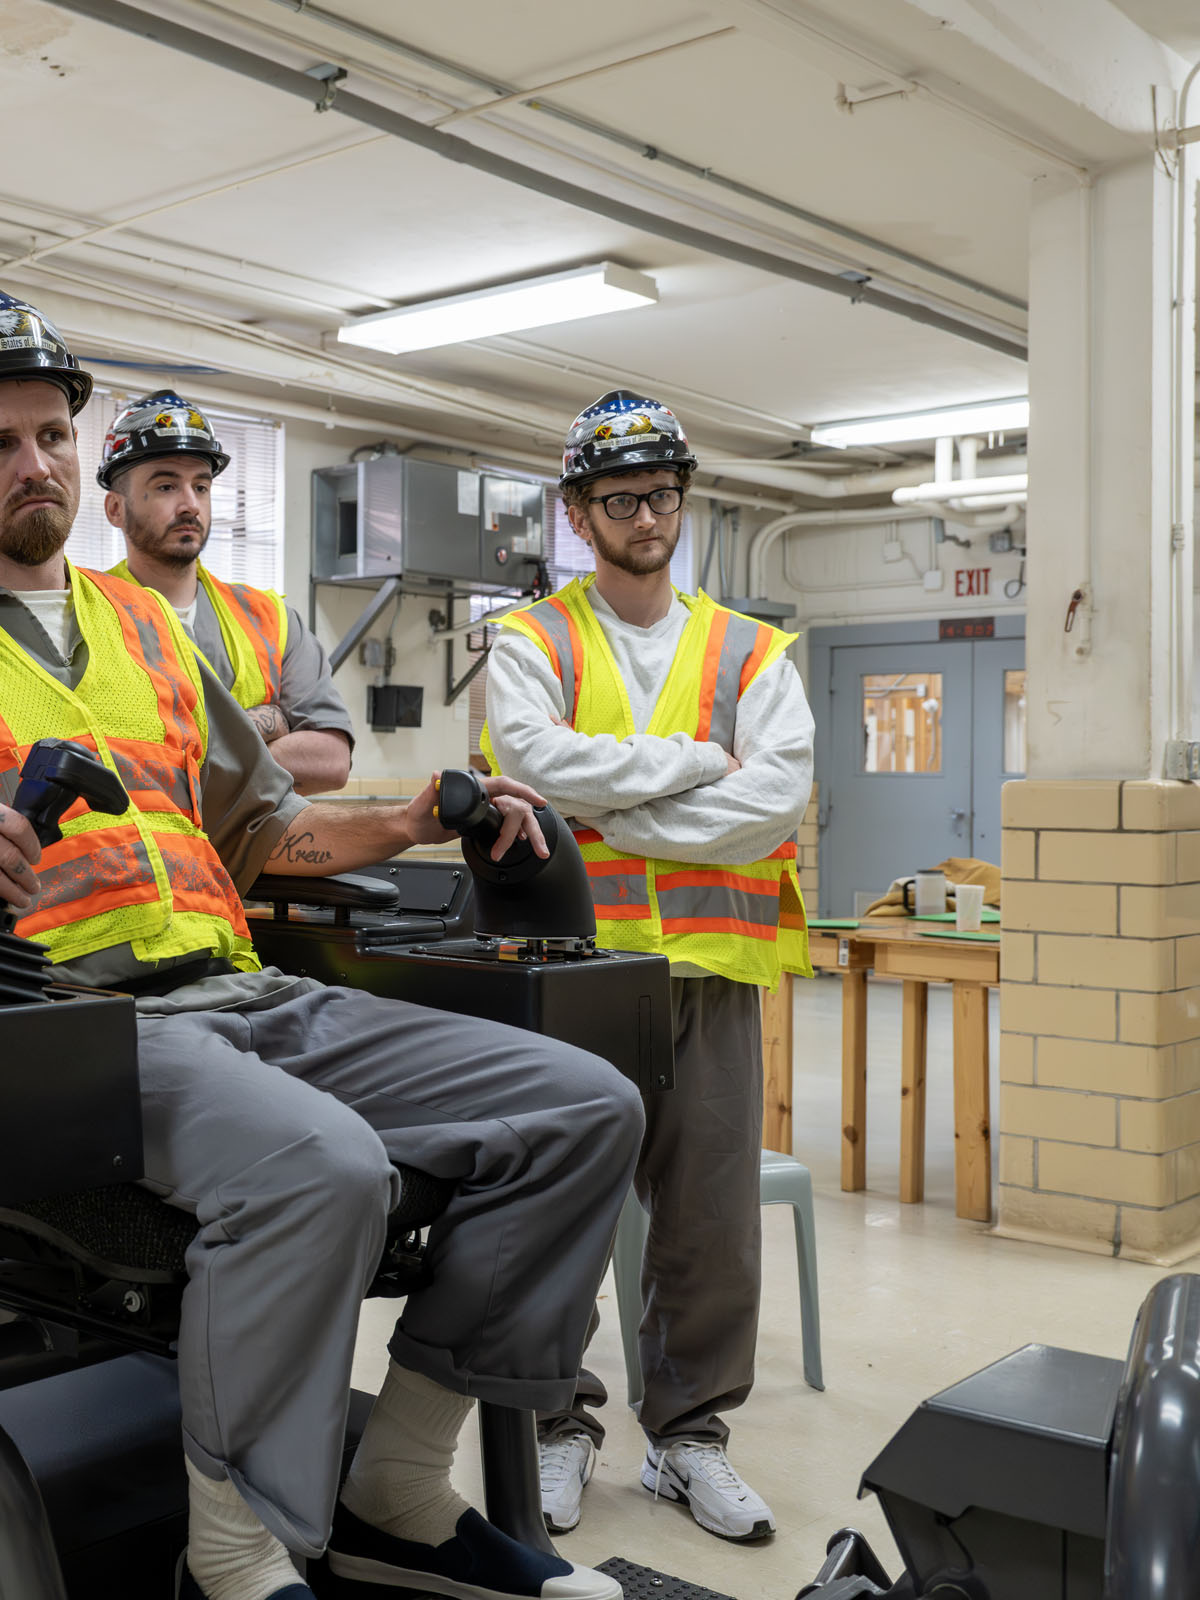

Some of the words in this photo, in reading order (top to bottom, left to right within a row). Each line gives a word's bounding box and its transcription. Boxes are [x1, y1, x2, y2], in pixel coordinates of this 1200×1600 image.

[1, 339, 22, 349] States
[24, 338, 30, 347] of
[31, 337, 54, 351] Aerica
[955, 568, 991, 597] EXIT
[268, 830, 333, 864] Krew
